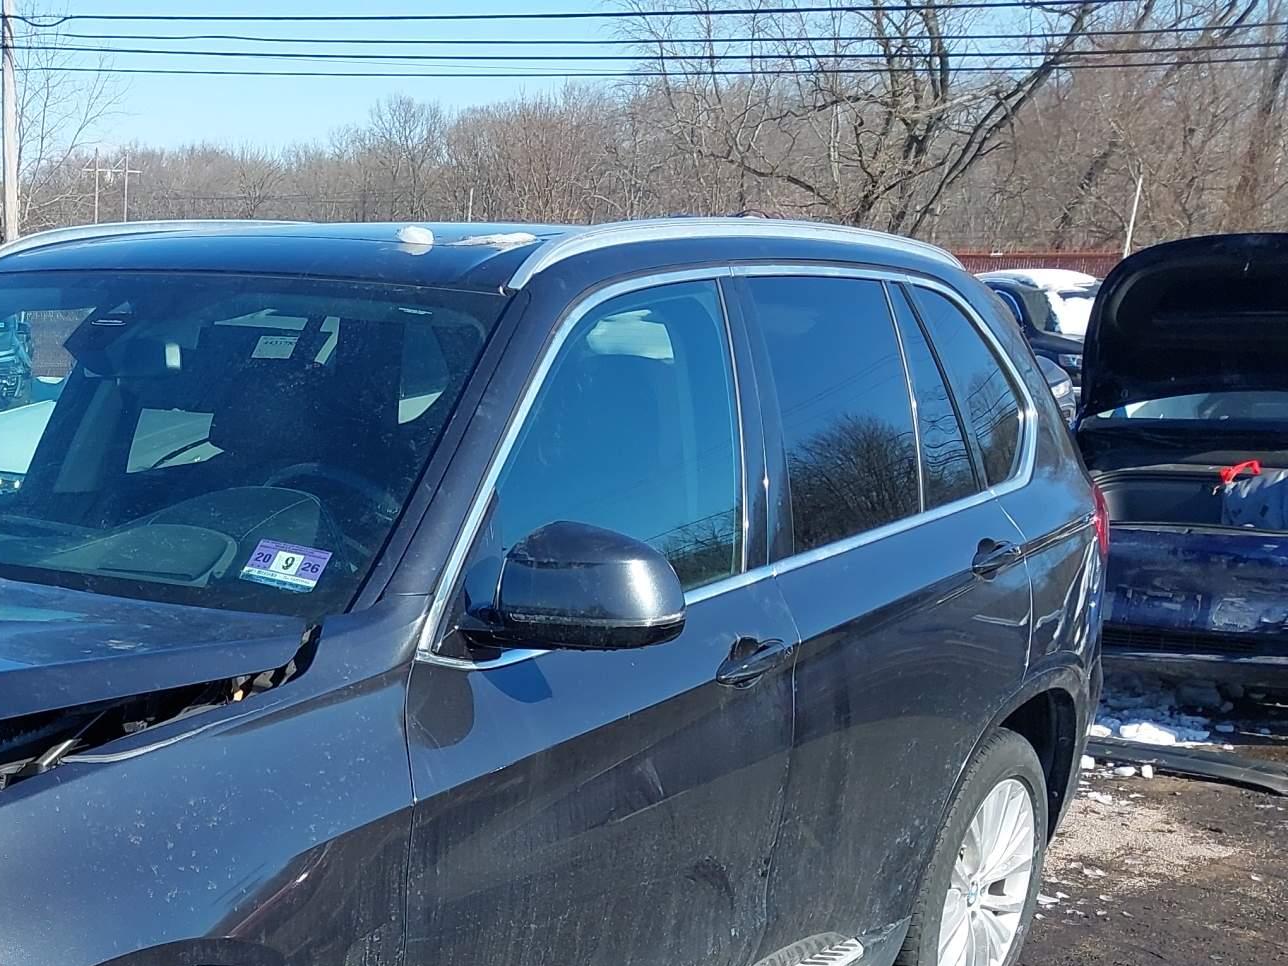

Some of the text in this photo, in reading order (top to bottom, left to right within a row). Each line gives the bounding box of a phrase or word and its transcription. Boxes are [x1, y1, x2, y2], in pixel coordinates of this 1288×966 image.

[255, 551, 321, 574] 20 9 26
